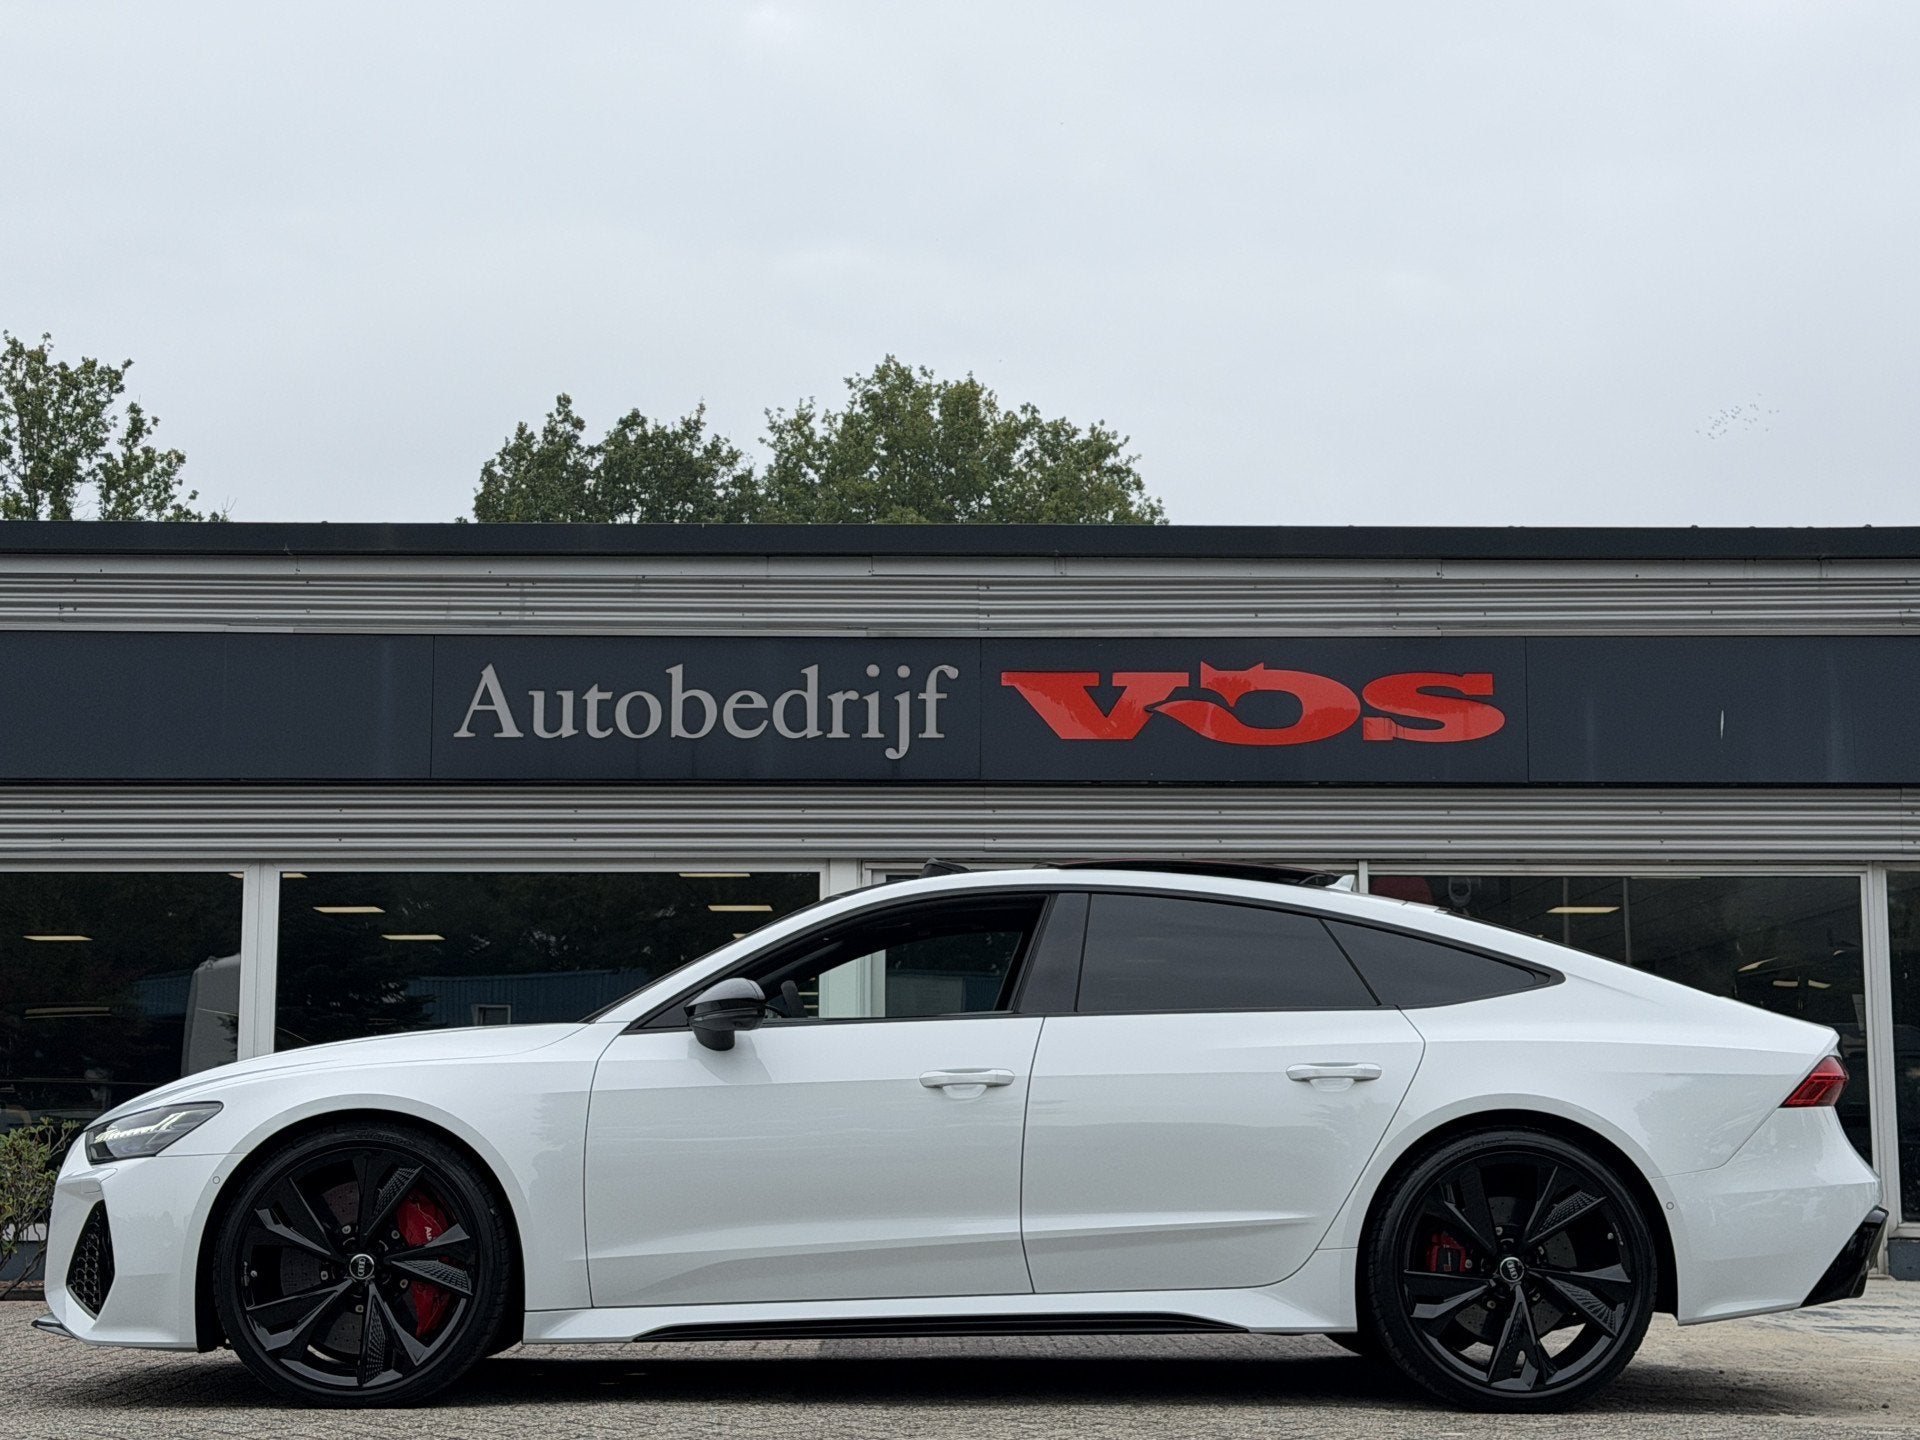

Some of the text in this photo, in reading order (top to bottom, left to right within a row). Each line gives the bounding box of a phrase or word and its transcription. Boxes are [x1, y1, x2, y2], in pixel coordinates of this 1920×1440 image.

[453, 661, 1505, 760] Autobedrijf VOS
[424, 1226, 433, 1242] Au
